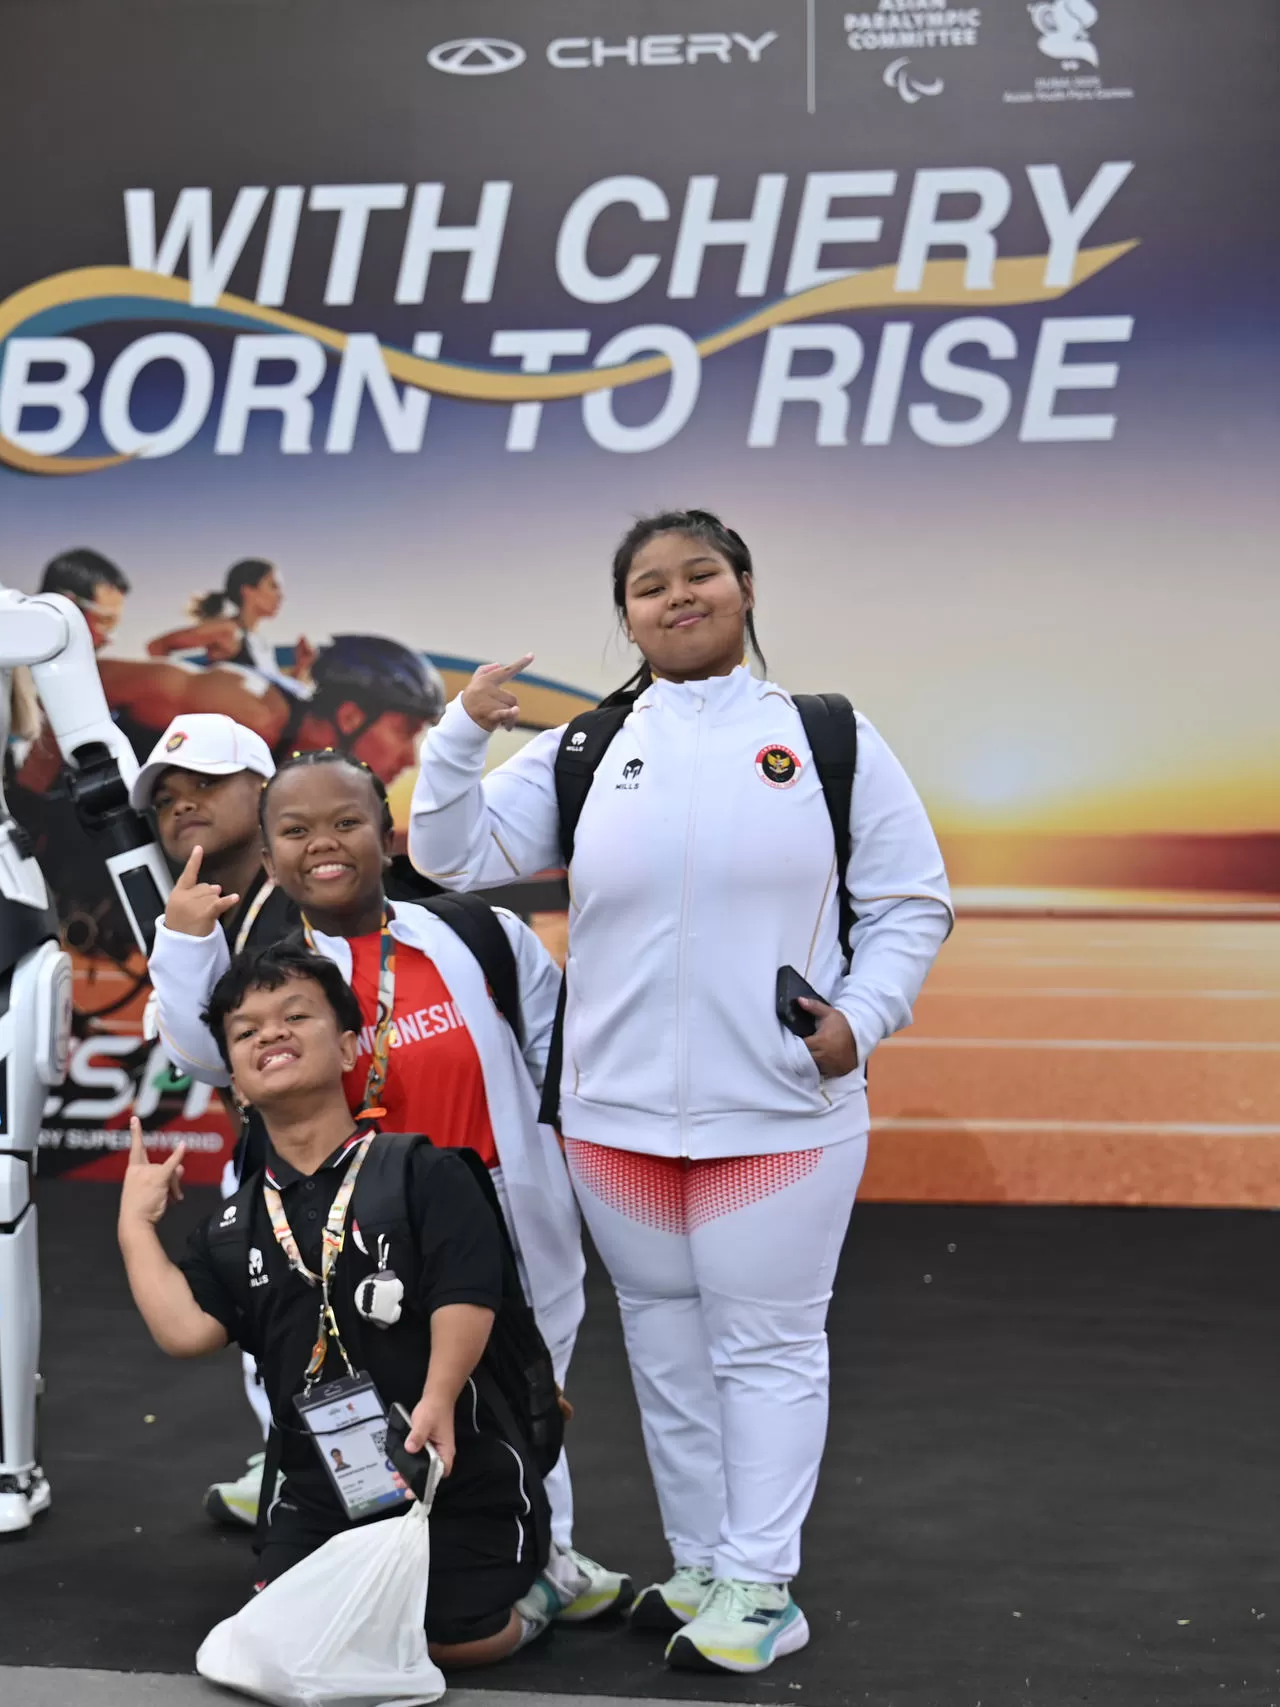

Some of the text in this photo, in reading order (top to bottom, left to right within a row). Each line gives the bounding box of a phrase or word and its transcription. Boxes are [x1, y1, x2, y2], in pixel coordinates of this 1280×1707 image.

[844, 8, 981, 32] PARALYMPIC
[847, 27, 977, 51] COMMITTEE
[546, 31, 778, 69] CHERY
[124, 162, 1134, 306] WITH CHERY
[490, 324, 702, 453] TO
[747, 316, 1134, 447] RISE
[615, 783, 640, 791] MILLS
[357, 1001, 466, 1056] NONESI
[42, 1036, 213, 1119] SH
